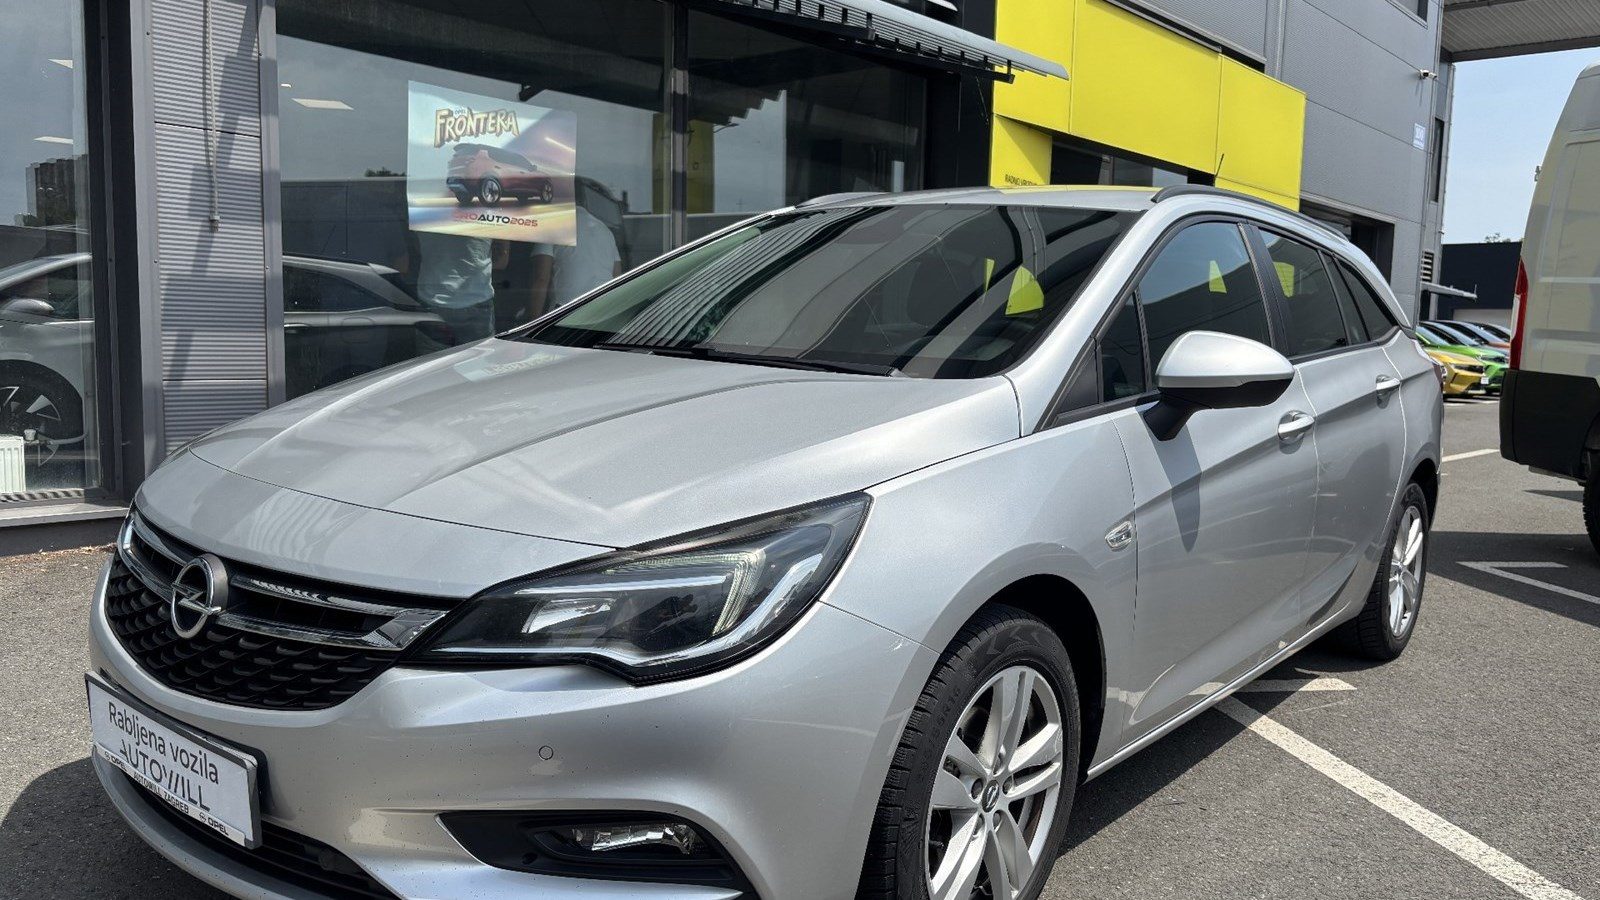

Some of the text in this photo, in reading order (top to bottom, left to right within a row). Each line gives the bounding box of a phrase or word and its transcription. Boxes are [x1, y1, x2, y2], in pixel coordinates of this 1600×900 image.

[434, 107, 520, 148] FRONTERA
[109, 701, 219, 784] Rabljena vozila
[120, 738, 210, 812] AUTOWILL
[111, 755, 128, 772] OPEL
[164, 790, 189, 814] ZAGREB
[208, 817, 230, 836] OPEL
